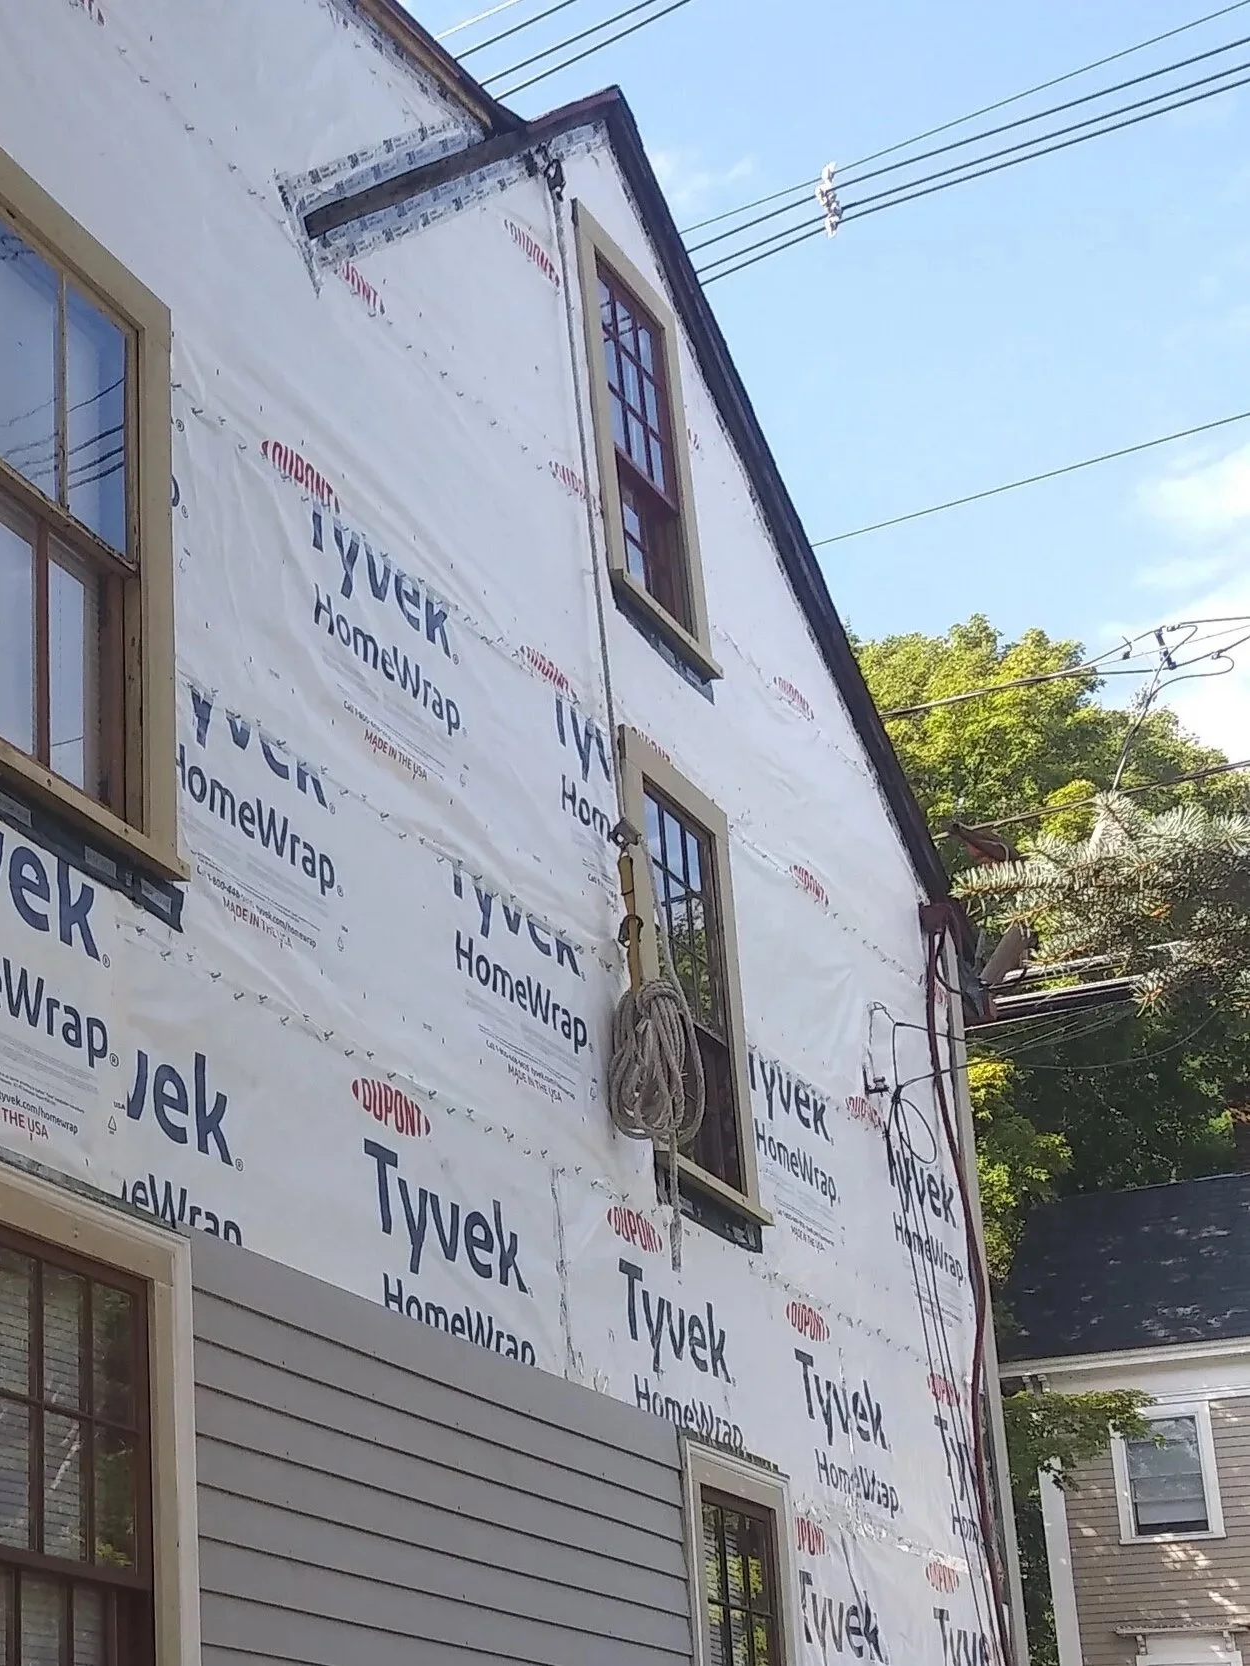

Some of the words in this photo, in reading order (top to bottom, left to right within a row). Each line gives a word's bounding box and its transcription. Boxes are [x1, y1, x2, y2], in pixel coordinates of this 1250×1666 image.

[314, 583, 461, 737] HomeWrap
[364, 730, 387, 753] MADE
[388, 745, 397, 759] IN
[398, 752, 412, 769] THE
[413, 762, 428, 781] USA
[455, 929, 588, 1055] HomeWrap
[1, 1106, 26, 1129] THE
[27, 1117, 49, 1140] USA
[362, 1078, 423, 1137] DUPONT
[754, 1118, 837, 1208] HomeWrap
[363, 1138, 529, 1294] Tyvek
[619, 1257, 732, 1384] Tyvek
[794, 1348, 888, 1451] Tyvek
